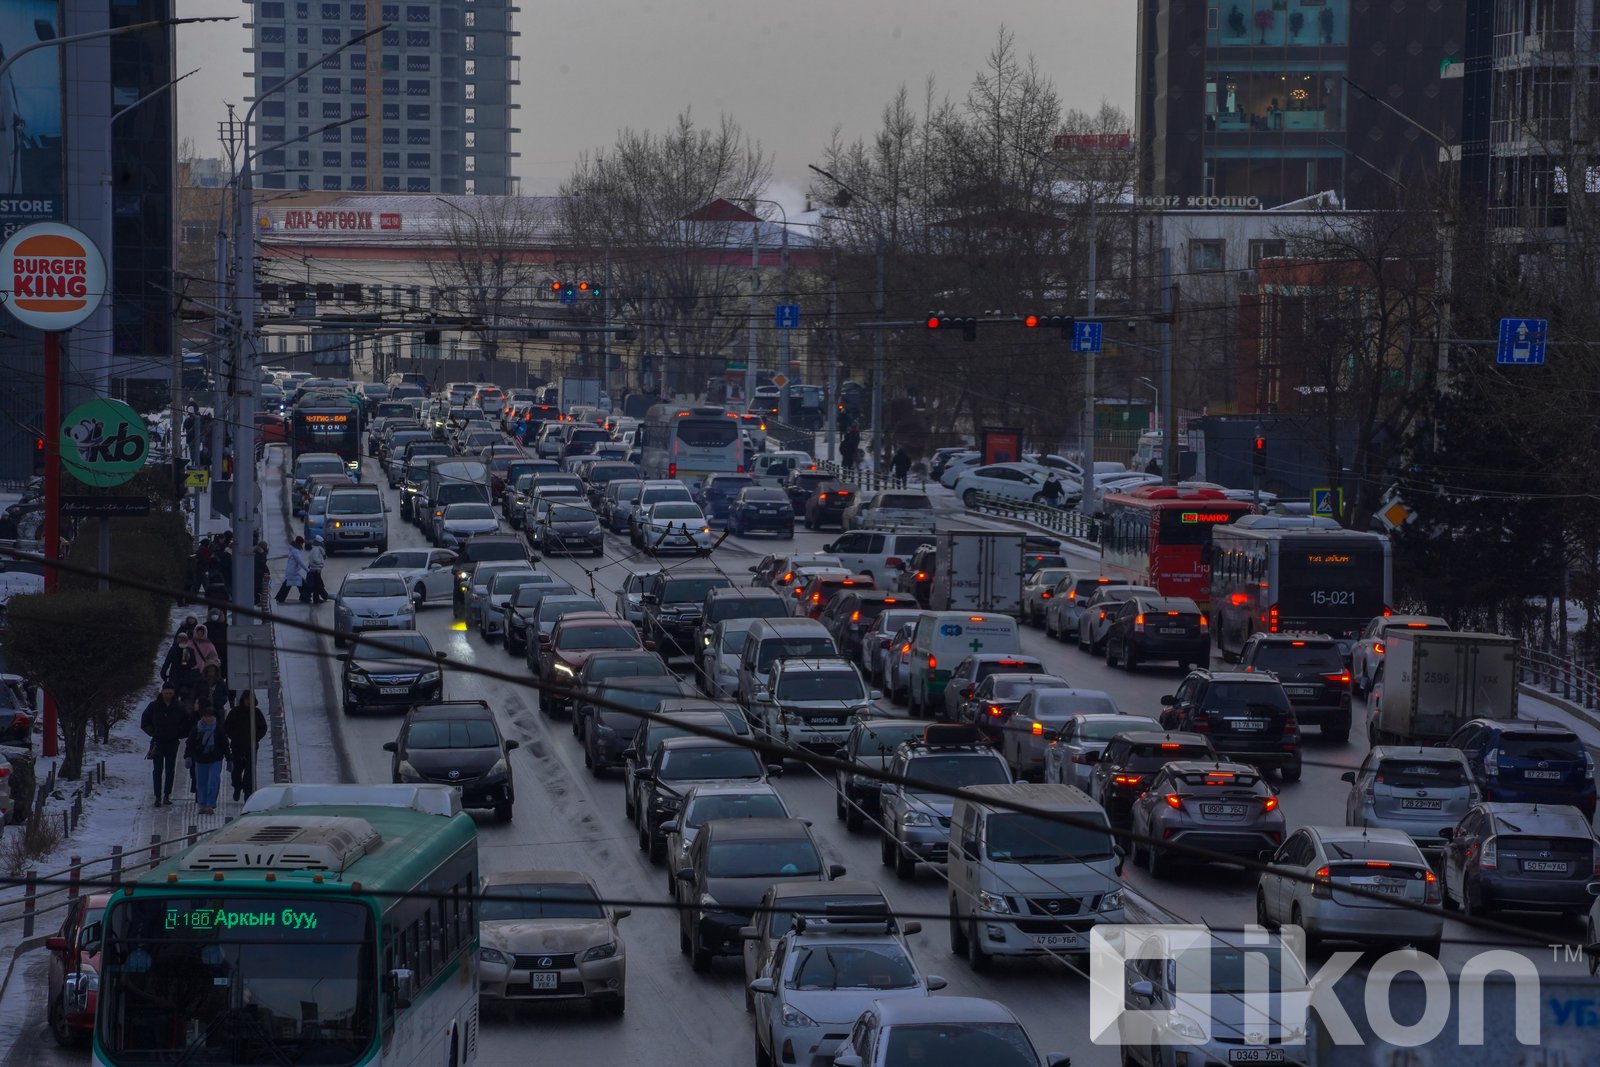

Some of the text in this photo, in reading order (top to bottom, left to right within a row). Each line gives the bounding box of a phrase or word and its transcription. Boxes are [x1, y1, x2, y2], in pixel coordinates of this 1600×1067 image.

[0, 200, 53, 212] STORE
[13, 258, 87, 275] BURGER
[13, 274, 87, 298] KING
[1310, 591, 1355, 605] 15-021
[810, 716, 839, 724] NISSAN
[1236, 1050, 1259, 1060] 0349
